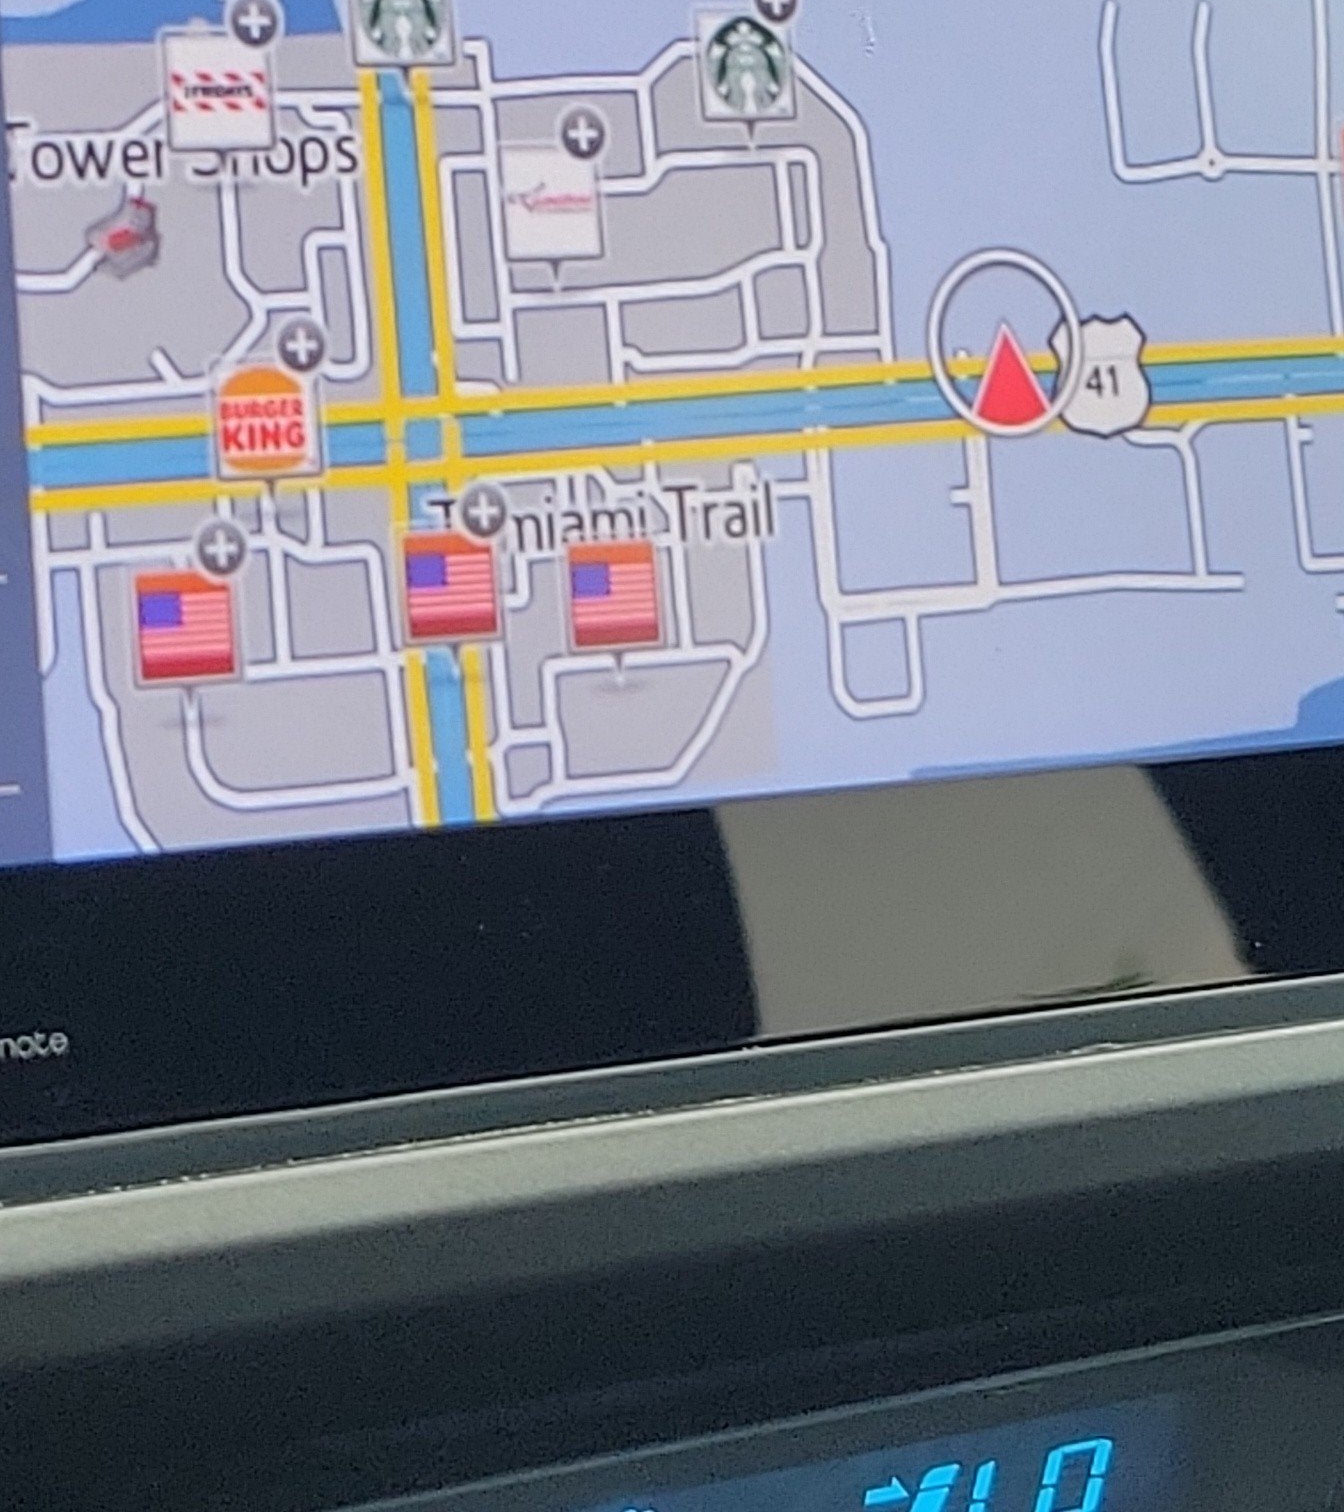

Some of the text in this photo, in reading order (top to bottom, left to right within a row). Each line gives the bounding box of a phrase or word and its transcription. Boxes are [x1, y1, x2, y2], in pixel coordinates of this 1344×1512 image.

[192, 134, 359, 188] ops
[1085, 364, 1120, 398] 41
[220, 397, 304, 421] BURGER
[222, 421, 306, 452] KING
[427, 477, 775, 552] Tmiami Trail
